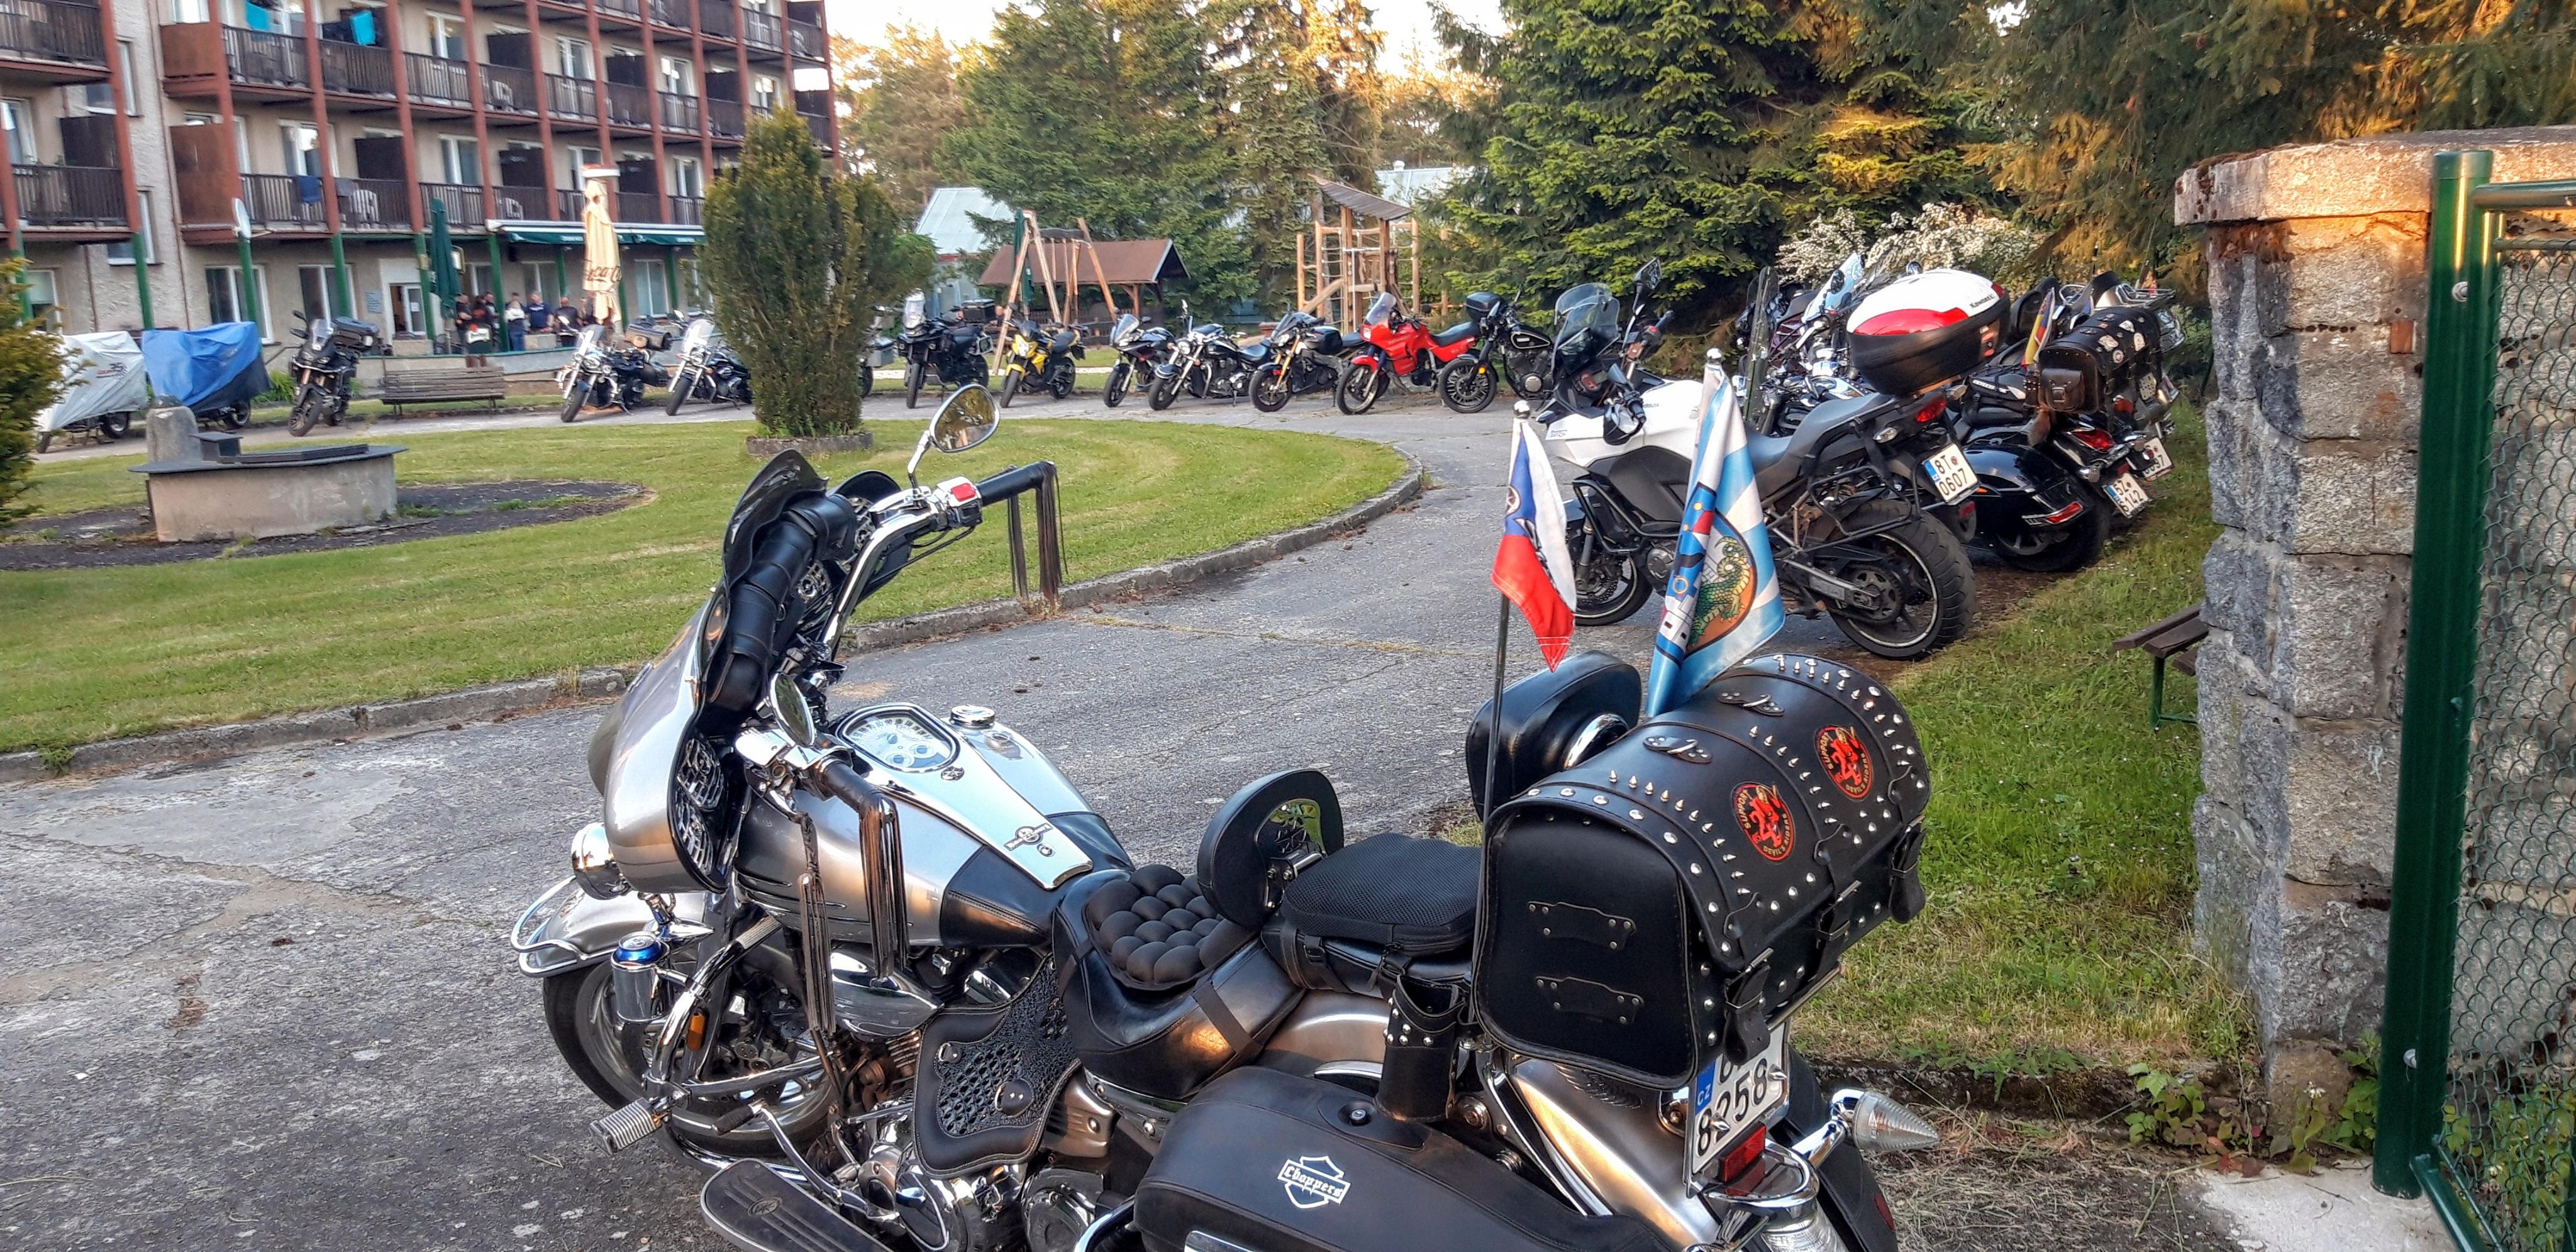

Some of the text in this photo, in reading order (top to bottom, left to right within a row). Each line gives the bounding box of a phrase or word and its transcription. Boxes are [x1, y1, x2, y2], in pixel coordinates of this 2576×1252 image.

[1935, 455, 1951, 474] 8T
[1939, 468, 1968, 496] 0607
[2114, 480, 2129, 496] 5Z
[2119, 490, 2144, 512] 6142
[1820, 732, 1834, 770] SUPPORT
[1845, 783, 1866, 794] DEVIL'S
[1738, 789, 1753, 829] SUPPORT
[1763, 845, 1785, 856] DEVIL'S
[1697, 1083, 1711, 1107] CZ
[1697, 1057, 1768, 1157] 8258
[1284, 1165, 1344, 1197] Choppers
